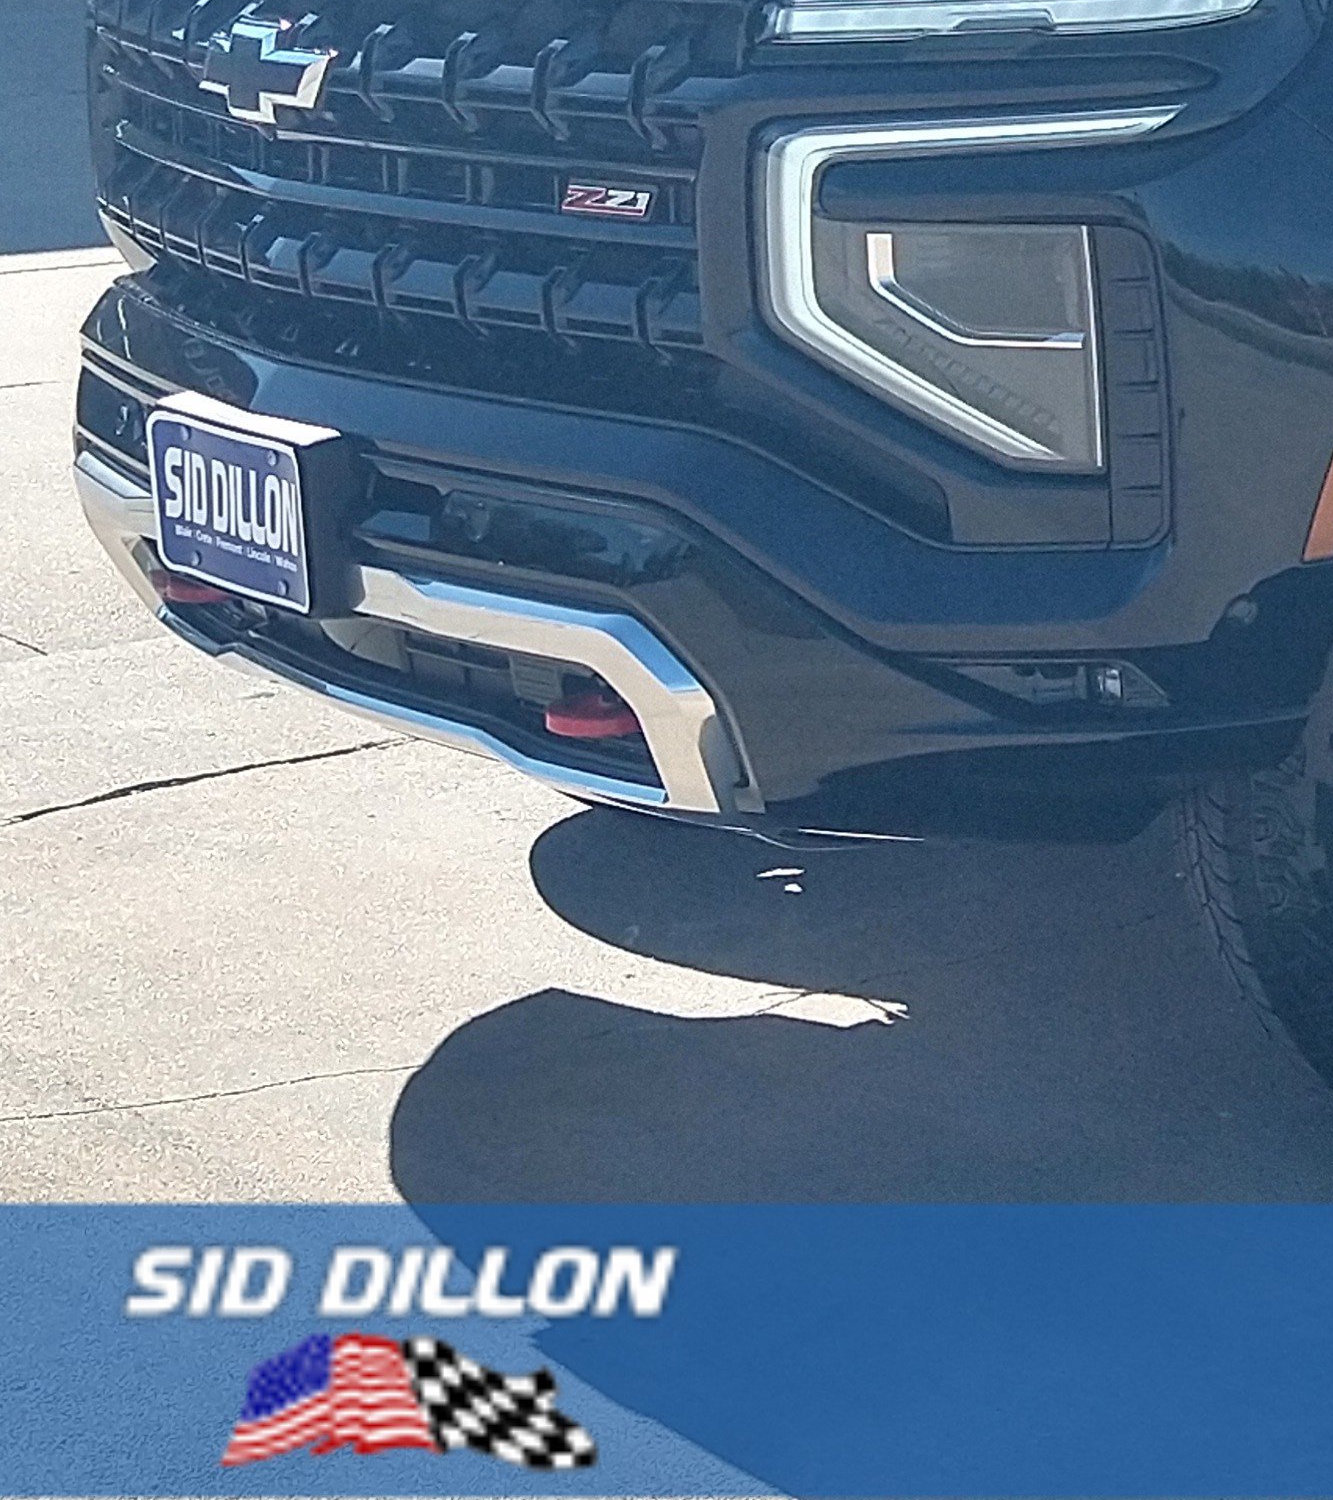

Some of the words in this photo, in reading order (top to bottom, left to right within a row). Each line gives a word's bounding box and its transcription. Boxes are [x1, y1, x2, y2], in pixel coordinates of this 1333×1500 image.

[562, 184, 650, 216] Z71
[164, 446, 208, 526] SID
[211, 458, 298, 557] DILLON
